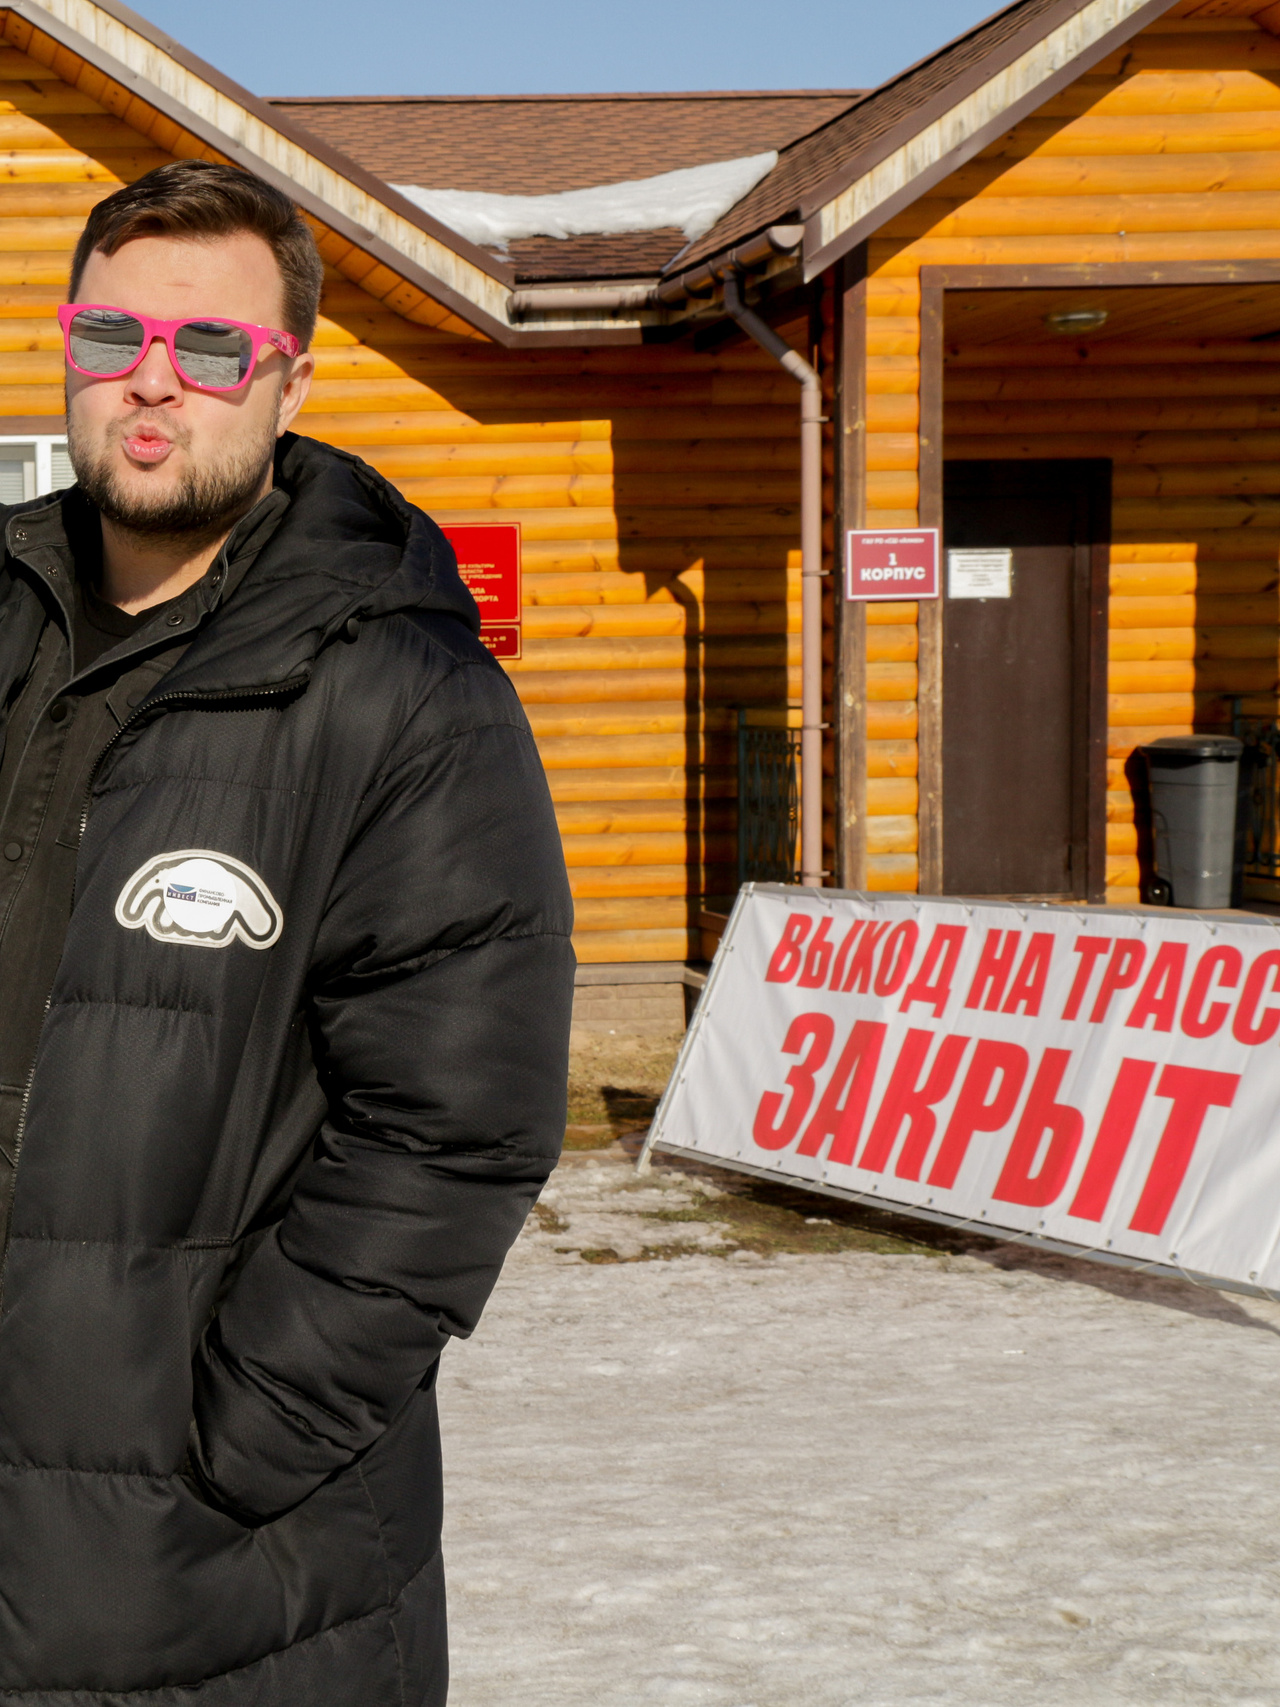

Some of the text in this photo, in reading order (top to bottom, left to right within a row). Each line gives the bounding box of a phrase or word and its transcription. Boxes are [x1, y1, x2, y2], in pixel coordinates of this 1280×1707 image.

[860, 566, 926, 581] КОРПУС
[888, 552, 898, 566] 1
[765, 913, 968, 1019] ВЫХОД
[964, 928, 1056, 1017] НА
[752, 1012, 1242, 1236] ЗАКРЫТ
